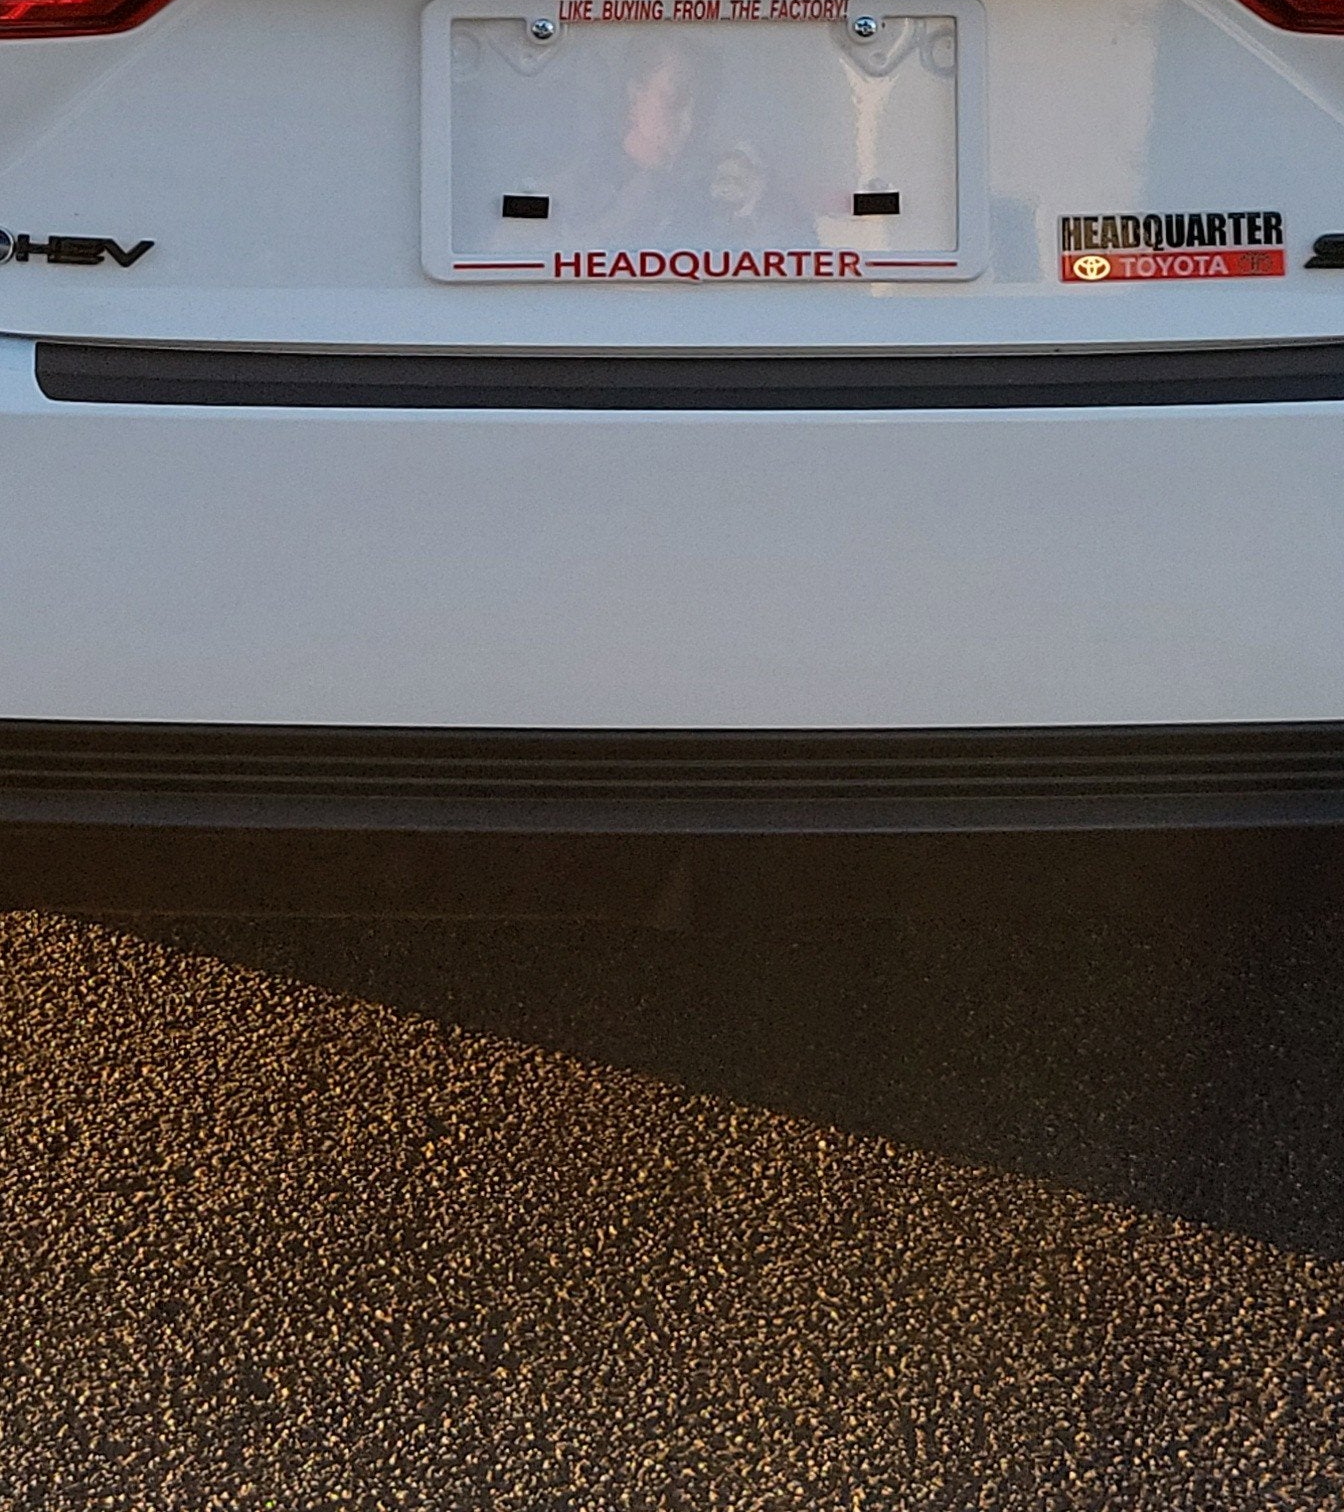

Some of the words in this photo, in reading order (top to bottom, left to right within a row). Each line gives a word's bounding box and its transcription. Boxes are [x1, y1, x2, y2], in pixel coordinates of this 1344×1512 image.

[559, 0, 593, 21] LIKE
[602, 0, 664, 21] BUYING
[673, 0, 721, 20] FROM
[730, 0, 761, 20] THE
[1061, 211, 1284, 251] HEADQUARTER
[15, 234, 155, 268] HEV
[554, 250, 862, 280] HEADQUARTER
[1119, 256, 1229, 278] TOYOTA
